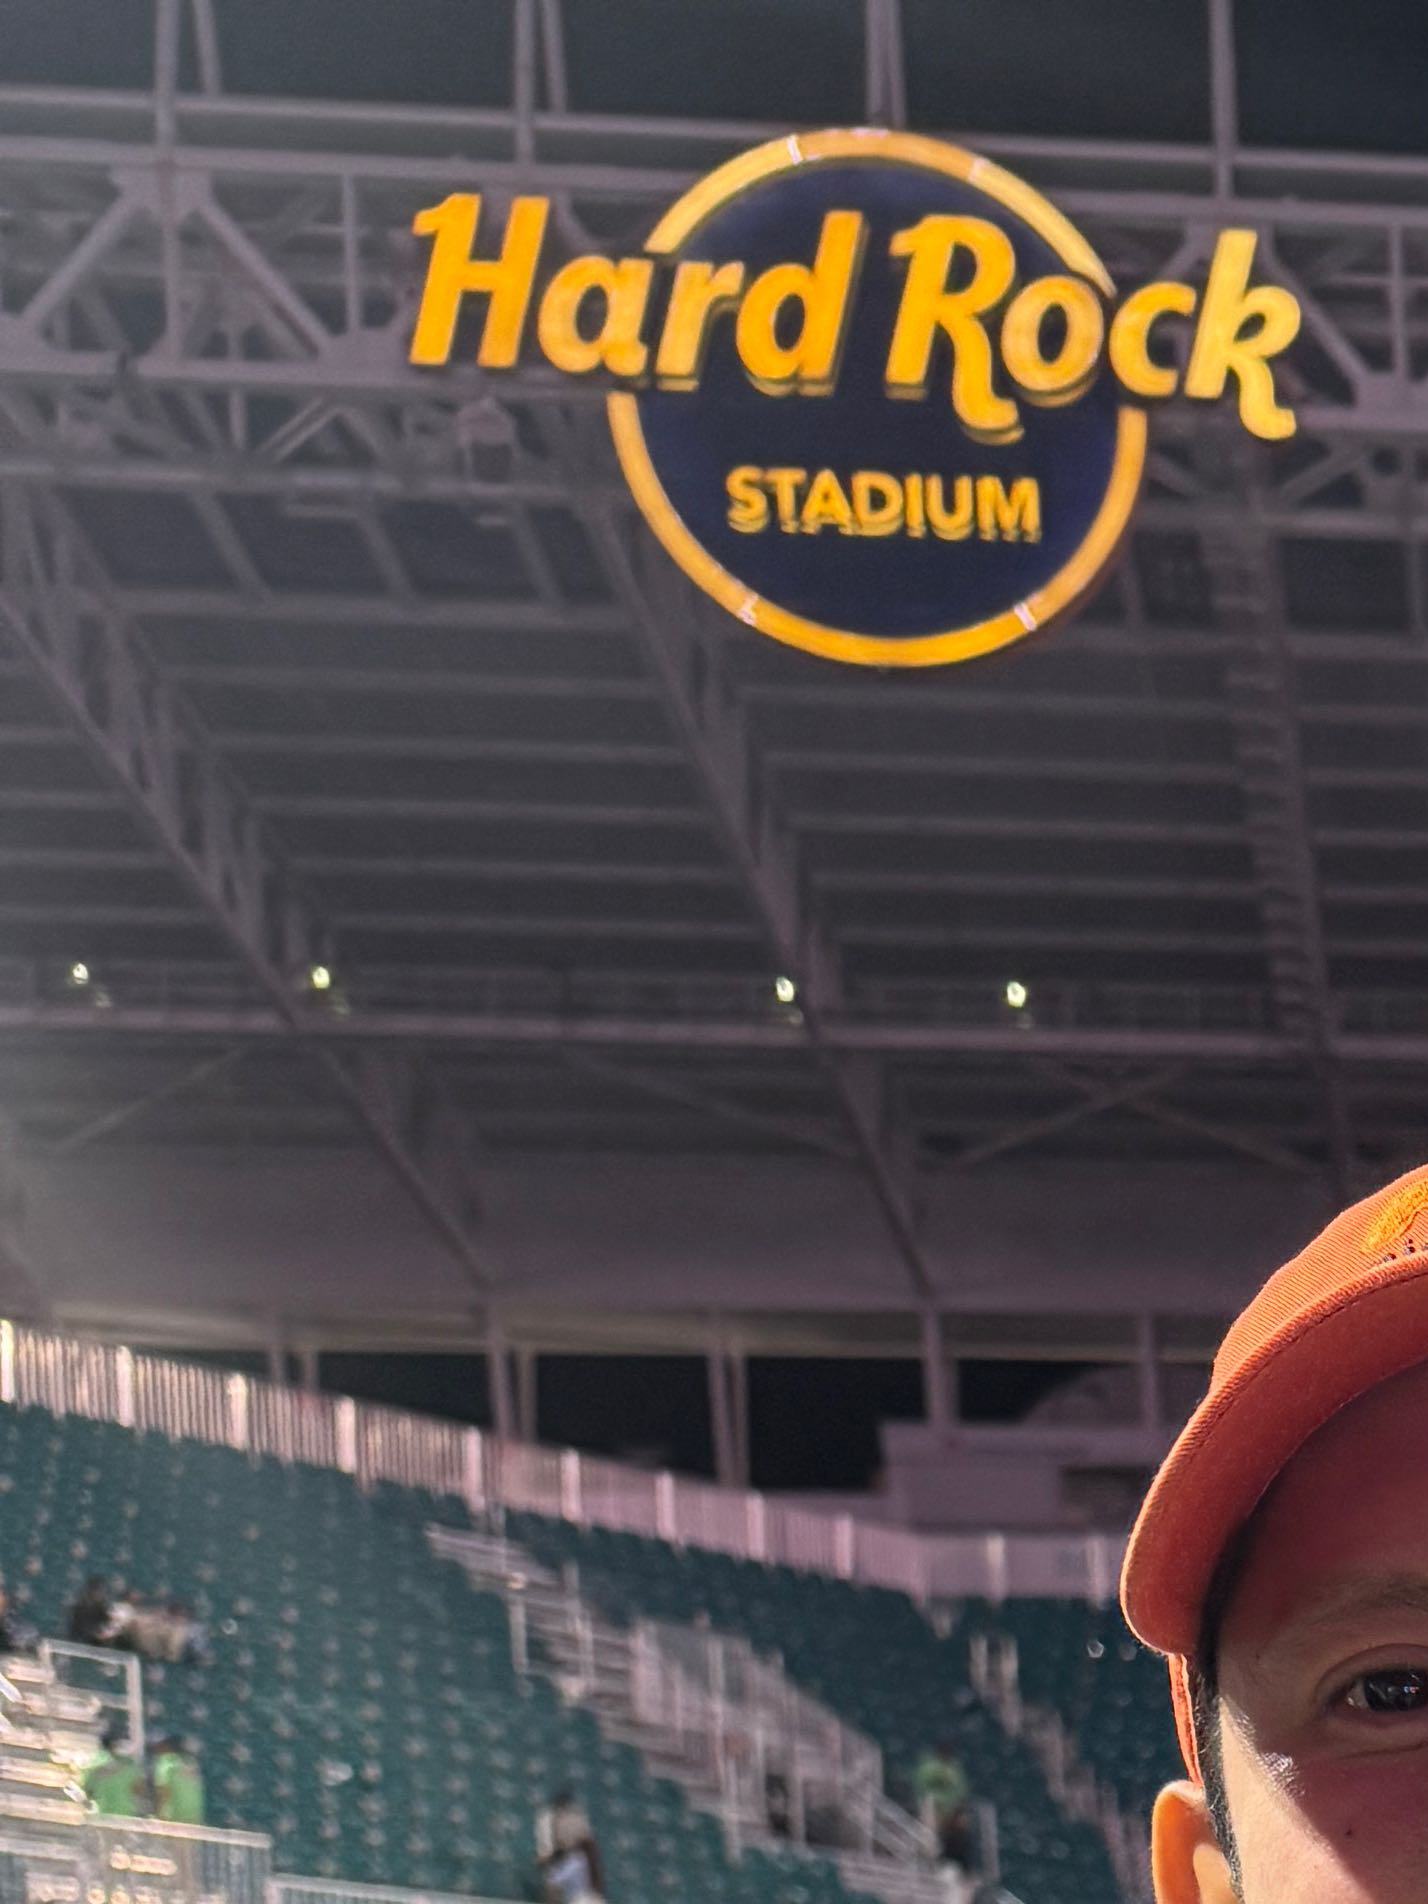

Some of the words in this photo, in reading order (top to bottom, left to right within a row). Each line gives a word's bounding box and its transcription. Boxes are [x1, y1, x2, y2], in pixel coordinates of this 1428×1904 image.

[409, 192, 867, 396] Hard
[888, 212, 1302, 443] Rock
[724, 465, 1043, 543] STADIUM
